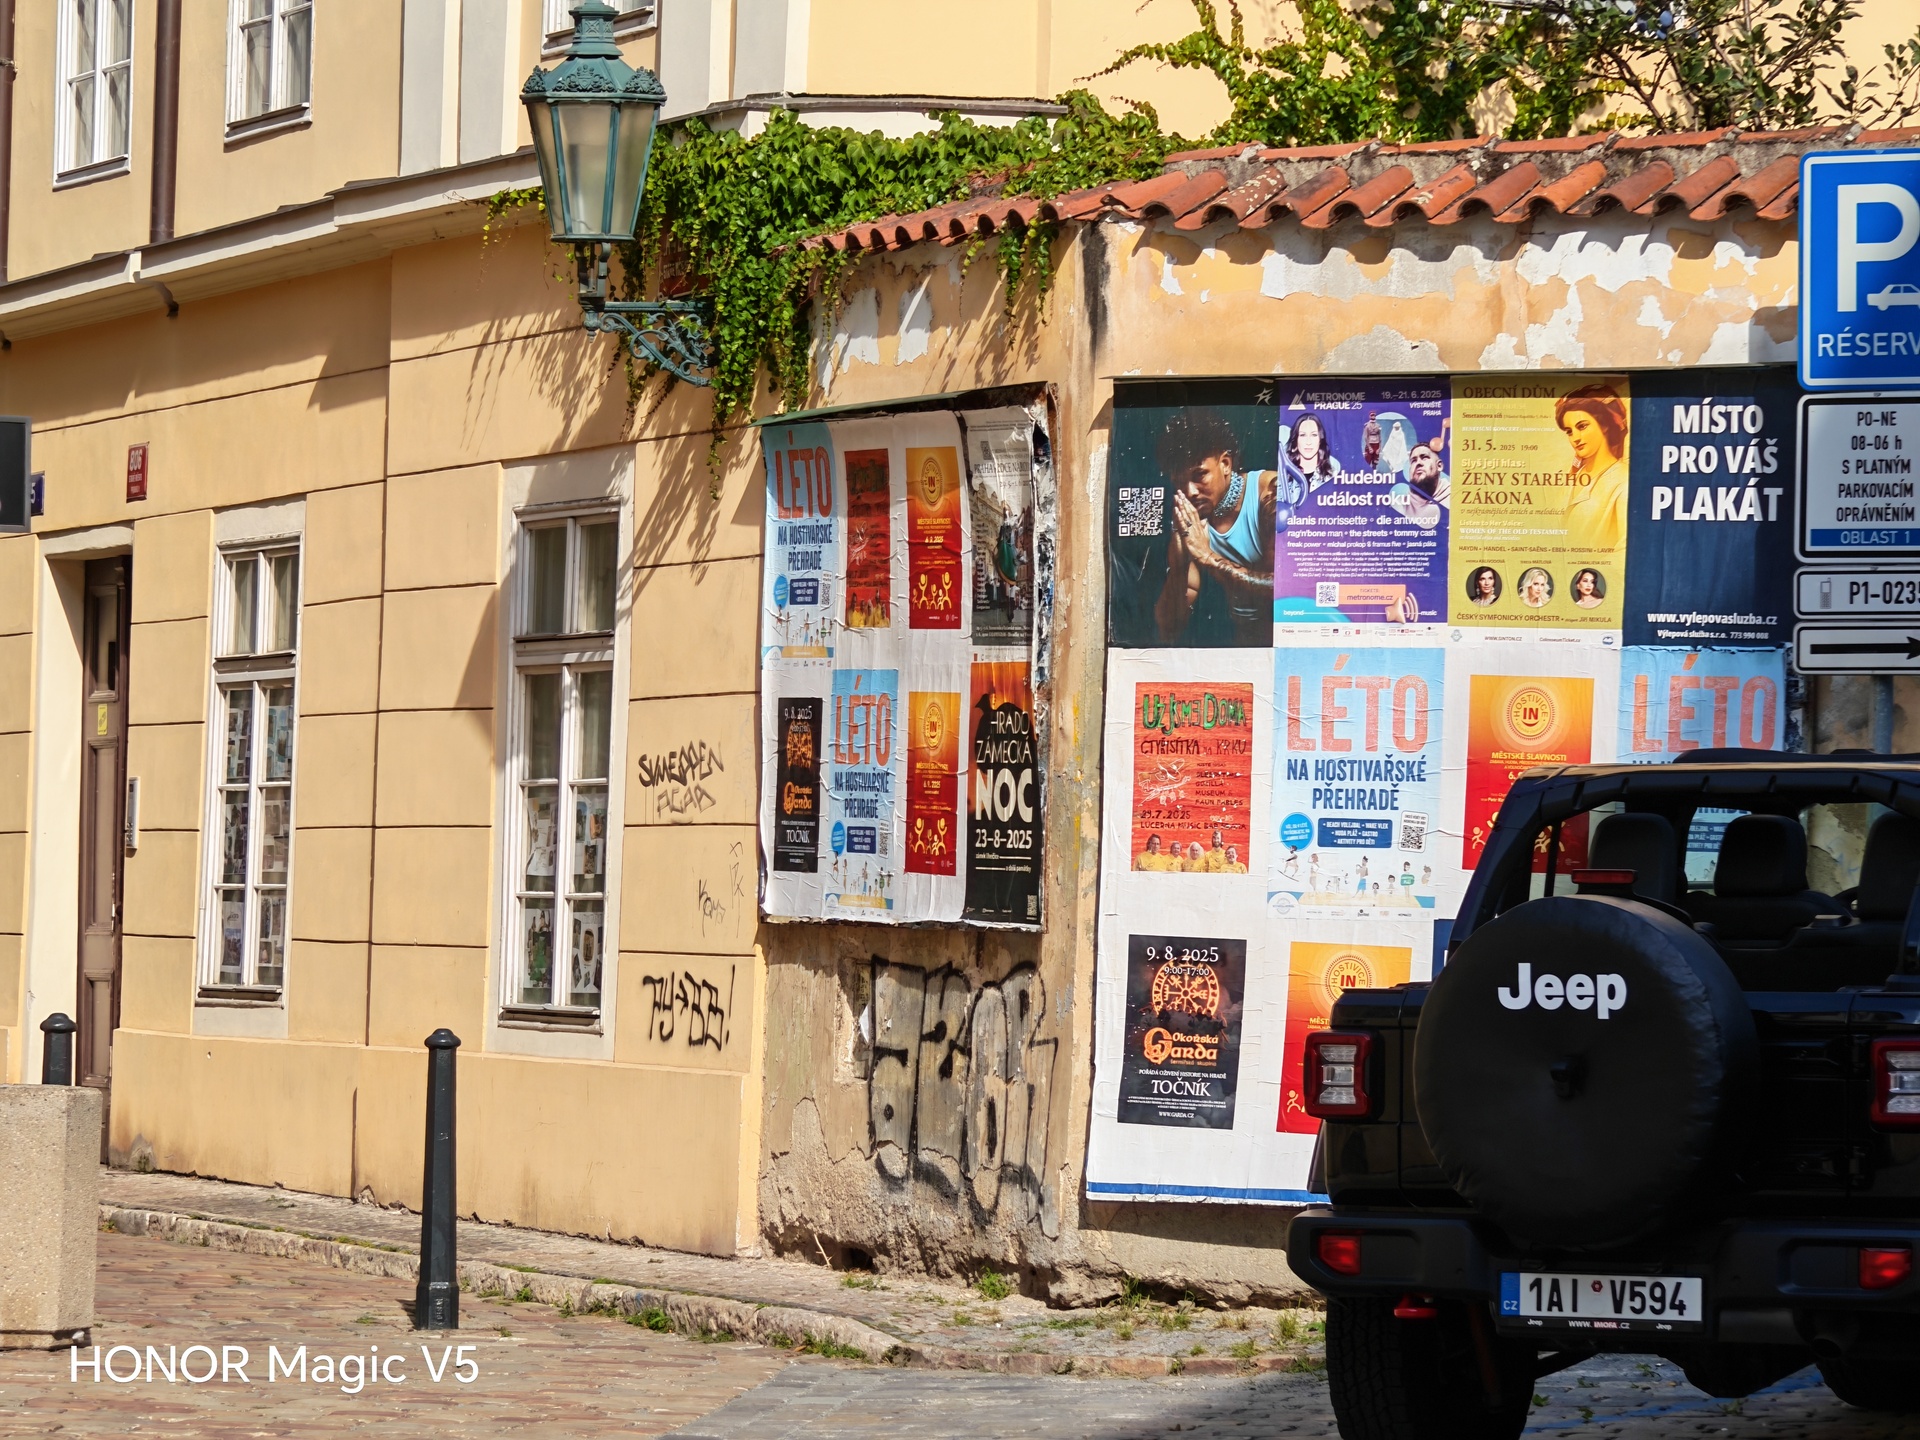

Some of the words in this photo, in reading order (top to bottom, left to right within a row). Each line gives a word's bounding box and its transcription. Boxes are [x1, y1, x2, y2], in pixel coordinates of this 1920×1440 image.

[1837, 183, 1920, 312] P
[1818, 326, 1920, 357] RÉSERV
[1306, 392, 1366, 401] METRONOME
[1420, 390, 1442, 399] 2025
[1463, 384, 1517, 399] OBECNÍ
[1521, 385, 1556, 399] DŮM
[1314, 401, 1350, 410] PRAGUE
[1409, 401, 1442, 409] VÝSTAVIŠTĚ
[1673, 397, 1764, 434] MÍSTO
[1857, 411, 1897, 427] PO-NE
[1462, 439, 1482, 451] 31.
[1485, 439, 1496, 451] 5.
[1851, 435, 1889, 450] 08-06
[1895, 435, 1902, 450] h
[1461, 458, 1482, 469] Slyš
[1483, 458, 1499, 469] její
[1500, 459, 1526, 468] hlas:
[1661, 445, 1718, 473] PRO
[1724, 438, 1778, 474] VÁŠ
[1842, 460, 1850, 474] S
[1855, 455, 1911, 474] PLATNÝM
[775, 430, 833, 519] LÉTO
[928, 475, 936, 487] IN
[1333, 470, 1396, 485] Hudební
[1461, 470, 1507, 486] ŽENY
[1511, 470, 1592, 486] STARÉHO
[1461, 489, 1533, 504] ZÁKONA
[1838, 479, 1914, 499] PARKOVACÍM
[1317, 491, 1372, 506] událost
[1376, 492, 1411, 506] roku
[1651, 478, 1784, 522] PLAKÁT
[1287, 516, 1316, 526] alanis
[1318, 515, 1368, 526] morissette
[1376, 515, 1392, 525] die
[1393, 515, 1438, 525] antwoord
[1836, 503, 1915, 522] OPRÁVNĚNÍM
[777, 525, 787, 546] NA
[789, 519, 833, 545] HOSTIVAŘSKÉ
[1349, 529, 1362, 537] the
[1362, 529, 1388, 537] streets
[1394, 530, 1419, 538] tommy
[1419, 529, 1437, 537] cash
[1840, 530, 1898, 544] OBLAST
[1904, 530, 1911, 544] 1
[1347, 541, 1366, 549] prokop
[787, 546, 823, 572] PŘEHRADĚ
[1346, 594, 1394, 602] metronome.cz
[1456, 612, 1478, 620] ČESKÝ
[1479, 613, 1523, 621] SYMFONICKÝ
[1647, 612, 1778, 626] www.vylepovasluzba.cz
[1657, 629, 1689, 639] Výlepová
[1287, 654, 1429, 753] LÉTO
[1632, 654, 1777, 752] LÉTO
[1513, 694, 1549, 718] HOSTIVICE
[797, 706, 812, 720] 2025
[834, 675, 891, 767] LÉTO
[1523, 707, 1539, 721] IN
[990, 711, 1030, 736] HRADO
[977, 736, 1032, 764] ZÁMECKÁ
[1217, 739, 1247, 755] KRKU
[1491, 750, 1525, 760] MĚSTSKÉ
[1526, 753, 1567, 761] SLAVNOSTI
[1287, 758, 1309, 781] NA
[1314, 754, 1427, 783] HOSTIVAŘSKÉ
[834, 771, 843, 792] NA
[844, 767, 890, 794] HOSTIVAŘSKÉ
[975, 768, 1033, 823] NOC
[1312, 782, 1399, 811] PŘEHRADĚ
[844, 794, 879, 819] PŘEHRADĚ
[786, 827, 810, 844] TOČNÍK
[1146, 946, 1160, 961] 9.
[1164, 945, 1178, 961] 8.
[1182, 947, 1219, 963] 2025
[1164, 967, 1210, 977] 9:00-17:00
[1340, 975, 1356, 987] IN
[1498, 963, 1627, 1020] Jeep
[1143, 1027, 1218, 1065] Garda
[1172, 1032, 1219, 1045] Okořská
[1159, 1069, 1180, 1077] OŽIVENÍ
[1151, 1077, 1211, 1096] TOČNÍK
[1503, 1301, 1518, 1311] CZ
[1529, 1277, 1578, 1312] 1AI
[1610, 1280, 1686, 1316] V594
[1656, 1323, 1672, 1331] Jeep
